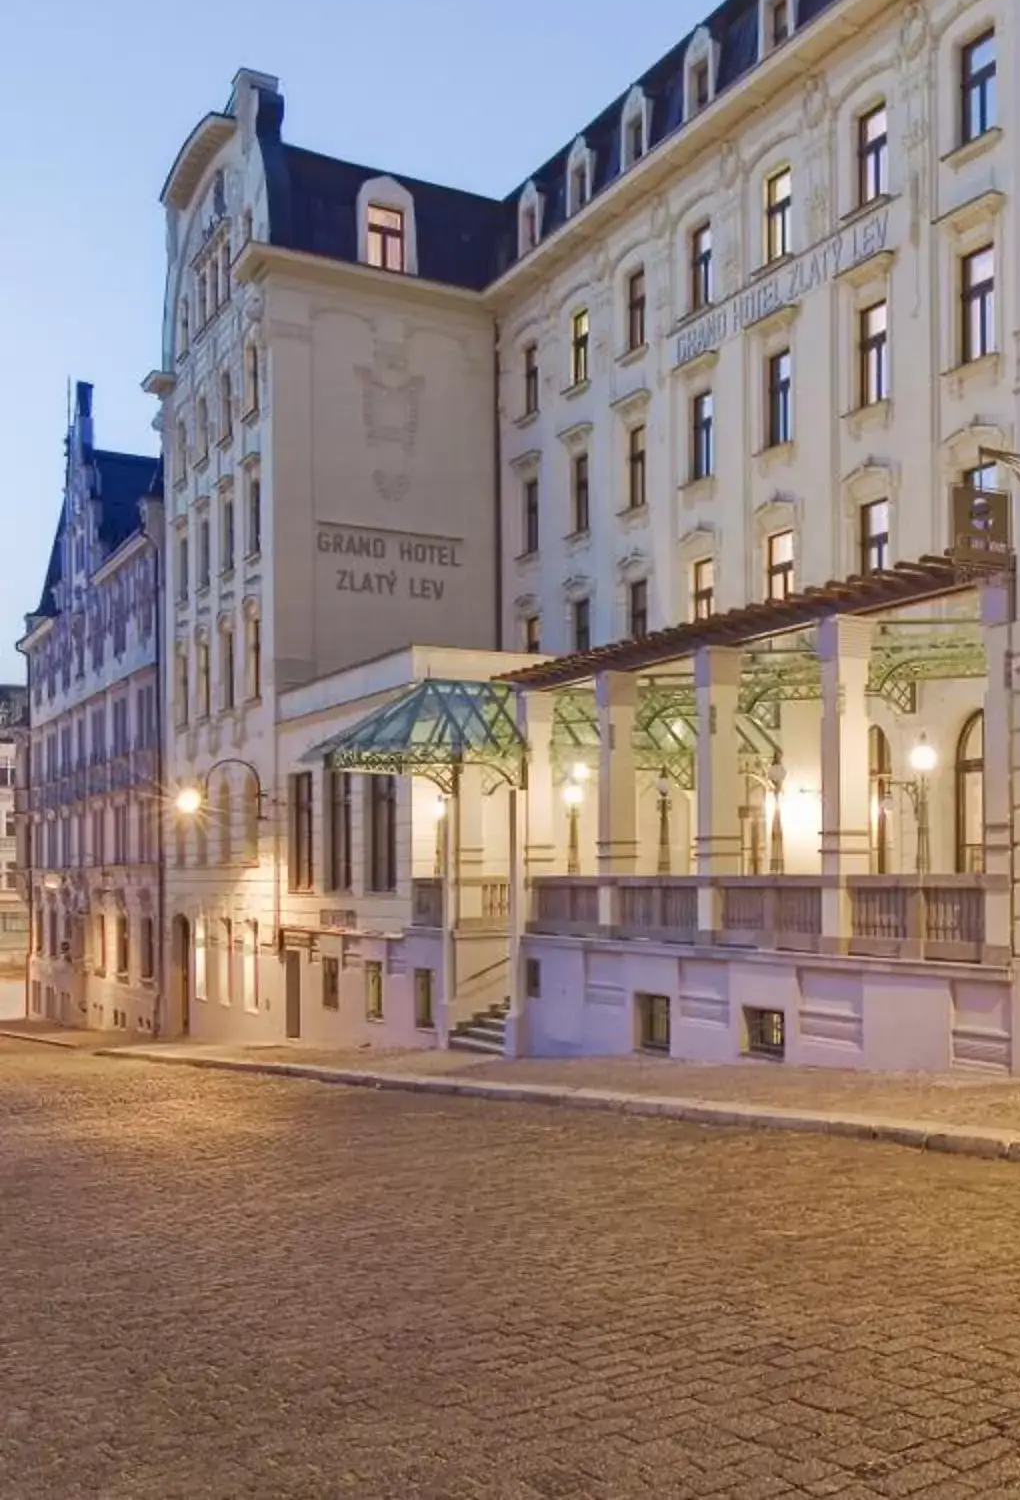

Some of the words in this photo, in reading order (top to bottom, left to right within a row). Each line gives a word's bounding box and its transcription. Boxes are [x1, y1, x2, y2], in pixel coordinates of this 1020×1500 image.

[677, 311, 727, 362] GRAND
[732, 279, 783, 332] HOTEL
[853, 210, 889, 258] LEV
[317, 532, 385, 559] GRAND
[400, 542, 462, 567] HOTEL
[336, 570, 397, 595] ZLATÝ
[410, 578, 445, 600] LEV
